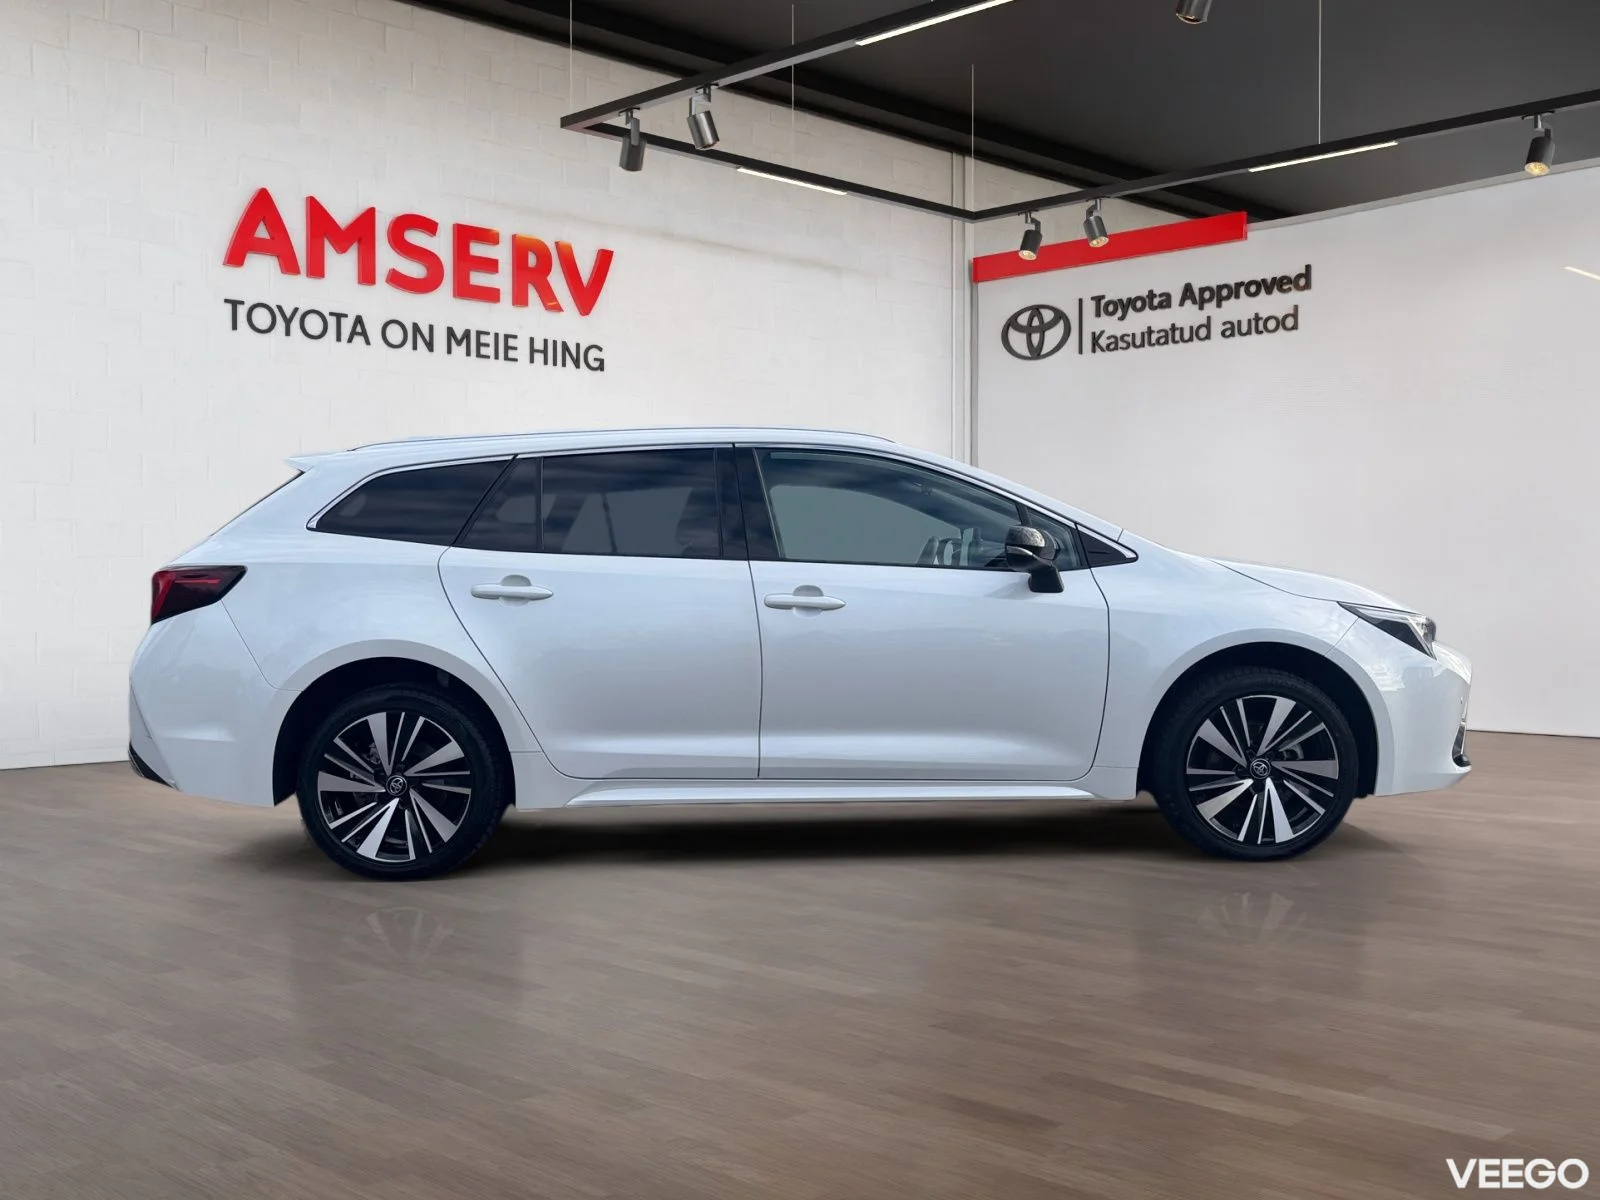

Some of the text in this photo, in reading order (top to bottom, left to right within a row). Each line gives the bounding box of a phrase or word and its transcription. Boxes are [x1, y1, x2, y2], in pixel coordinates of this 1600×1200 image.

[222, 187, 614, 317] AMSERV
[1090, 264, 1312, 321] Toyota Approved
[223, 298, 605, 372] TOYOTA ON MEIE HING
[1090, 304, 1299, 354] Kasutatud autod
